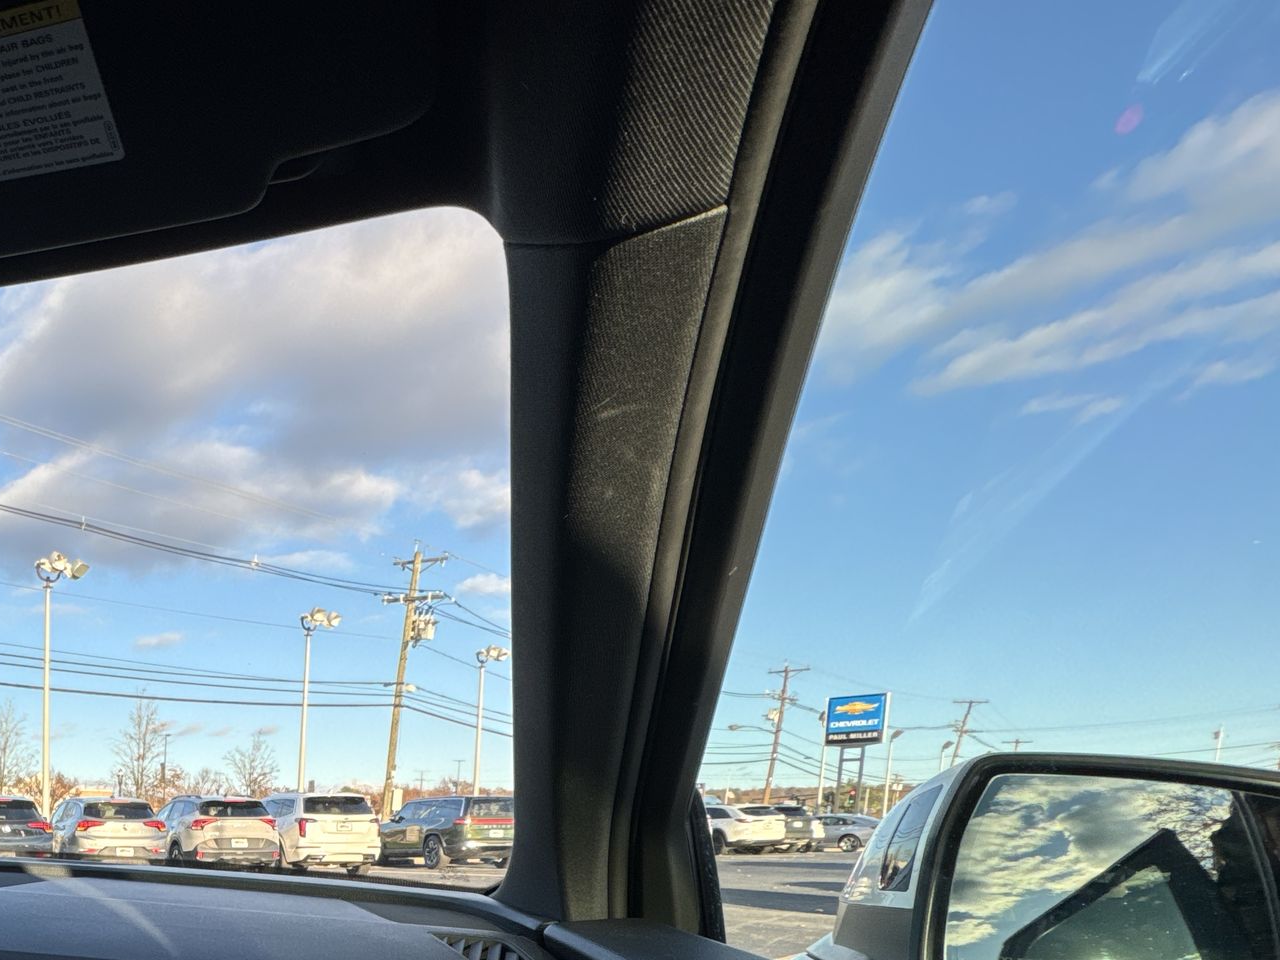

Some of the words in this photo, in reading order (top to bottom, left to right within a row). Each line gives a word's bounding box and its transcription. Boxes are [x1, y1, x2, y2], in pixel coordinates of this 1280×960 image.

[0, 42, 18, 54] AIR
[22, 33, 53, 48] BAGS
[35, 56, 79, 73] CHILDREN
[830, 719, 880, 728] CHEVROLET
[829, 733, 847, 741] PAUL
[849, 731, 878, 739] MILLER
